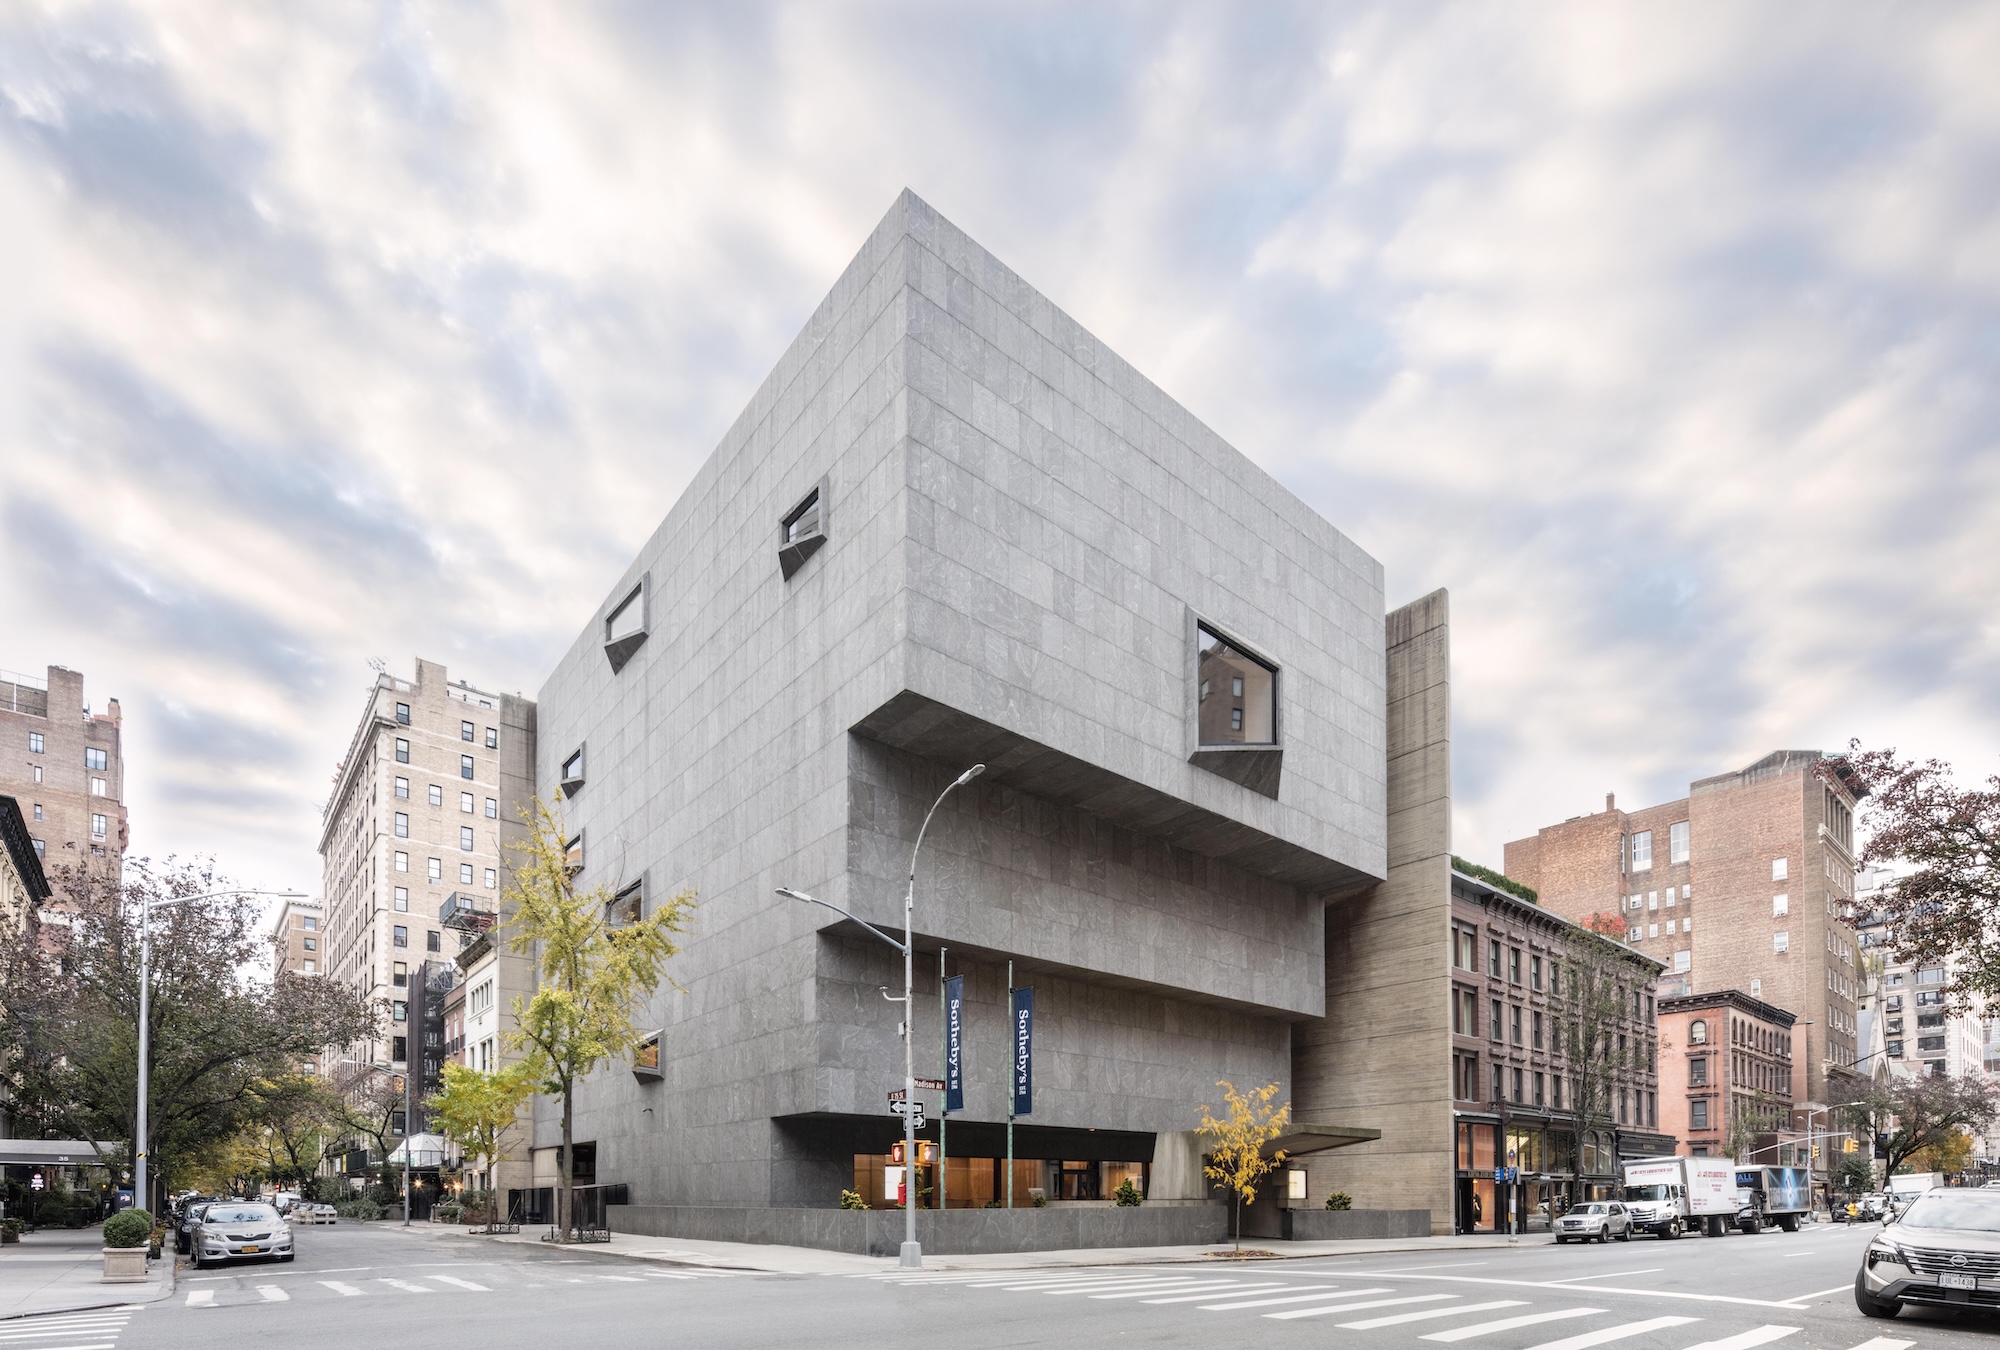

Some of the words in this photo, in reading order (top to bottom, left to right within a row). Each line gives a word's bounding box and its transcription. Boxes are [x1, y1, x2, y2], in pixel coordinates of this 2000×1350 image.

[949, 999, 960, 1078] Sotheby's
[1016, 1009, 1029, 1084] Sotheby's
[914, 1080, 935, 1089] Madison
[1736, 1173, 1754, 1182] ALL
